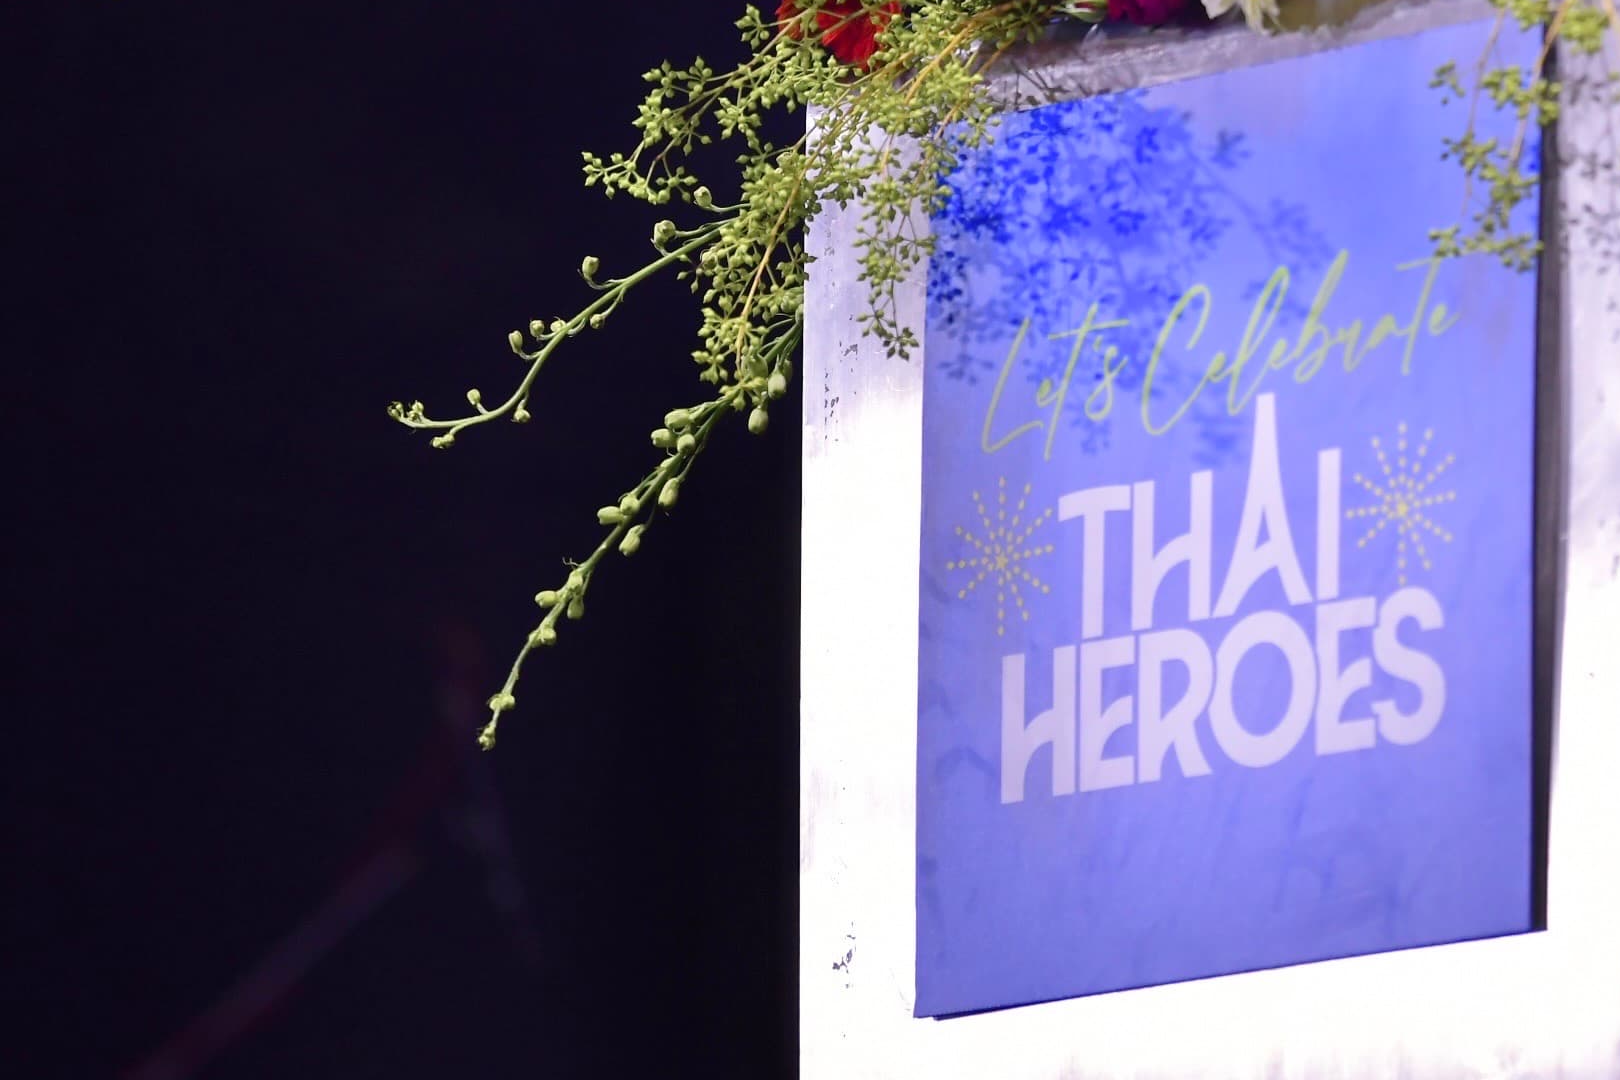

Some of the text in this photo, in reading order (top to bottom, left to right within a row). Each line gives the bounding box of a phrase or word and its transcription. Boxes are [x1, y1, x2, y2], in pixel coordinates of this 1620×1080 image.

[982, 250, 1459, 461] Let's Celebrate
[1058, 392, 1342, 640] THAI
[1001, 587, 1447, 805] HEROES
